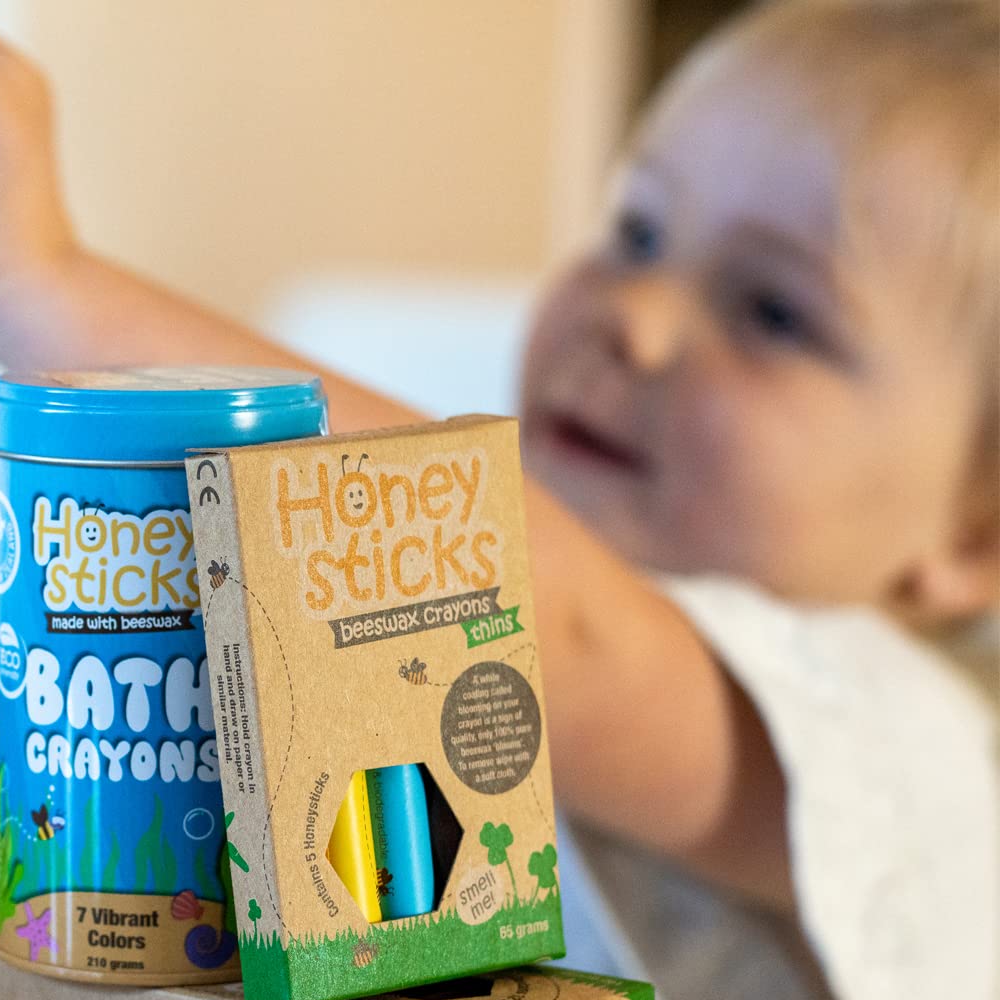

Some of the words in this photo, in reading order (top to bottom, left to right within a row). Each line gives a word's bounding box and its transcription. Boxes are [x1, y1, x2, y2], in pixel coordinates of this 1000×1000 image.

[276, 456, 481, 548] Honey
[37, 502, 195, 562] Honey
[48, 557, 201, 608] sticks
[305, 526, 497, 610] sticks
[52, 616, 84, 629] made
[87, 616, 117, 630] with
[121, 616, 182, 630] beeswax
[338, 612, 420, 644] beeswax
[423, 597, 491, 628] crayons
[471, 614, 513, 641] thins
[223, 644, 231, 673] hand
[26, 647, 216, 733] BATH
[233, 643, 246, 713] Instructions:
[217, 675, 227, 713] similar
[222, 716, 232, 764] material.
[229, 698, 237, 728] draw
[241, 715, 250, 740] Hold
[233, 730, 239, 744] on
[26, 732, 221, 782] CRAYONS
[234, 746, 242, 779] paper
[244, 743, 254, 781] crayon
[239, 782, 245, 794] or
[249, 784, 256, 794] in
[304, 772, 330, 849] Honeysticks
[305, 853, 317, 862] 5
[310, 866, 339, 918] Contains
[459, 870, 496, 905] smell
[76, 907, 86, 922] 7
[92, 908, 159, 928] Vibrant
[500, 925, 513, 939] 65
[516, 920, 549, 939] grams
[88, 929, 146, 950] Colors
[87, 957, 107, 967] 210
[110, 959, 144, 970] grams
